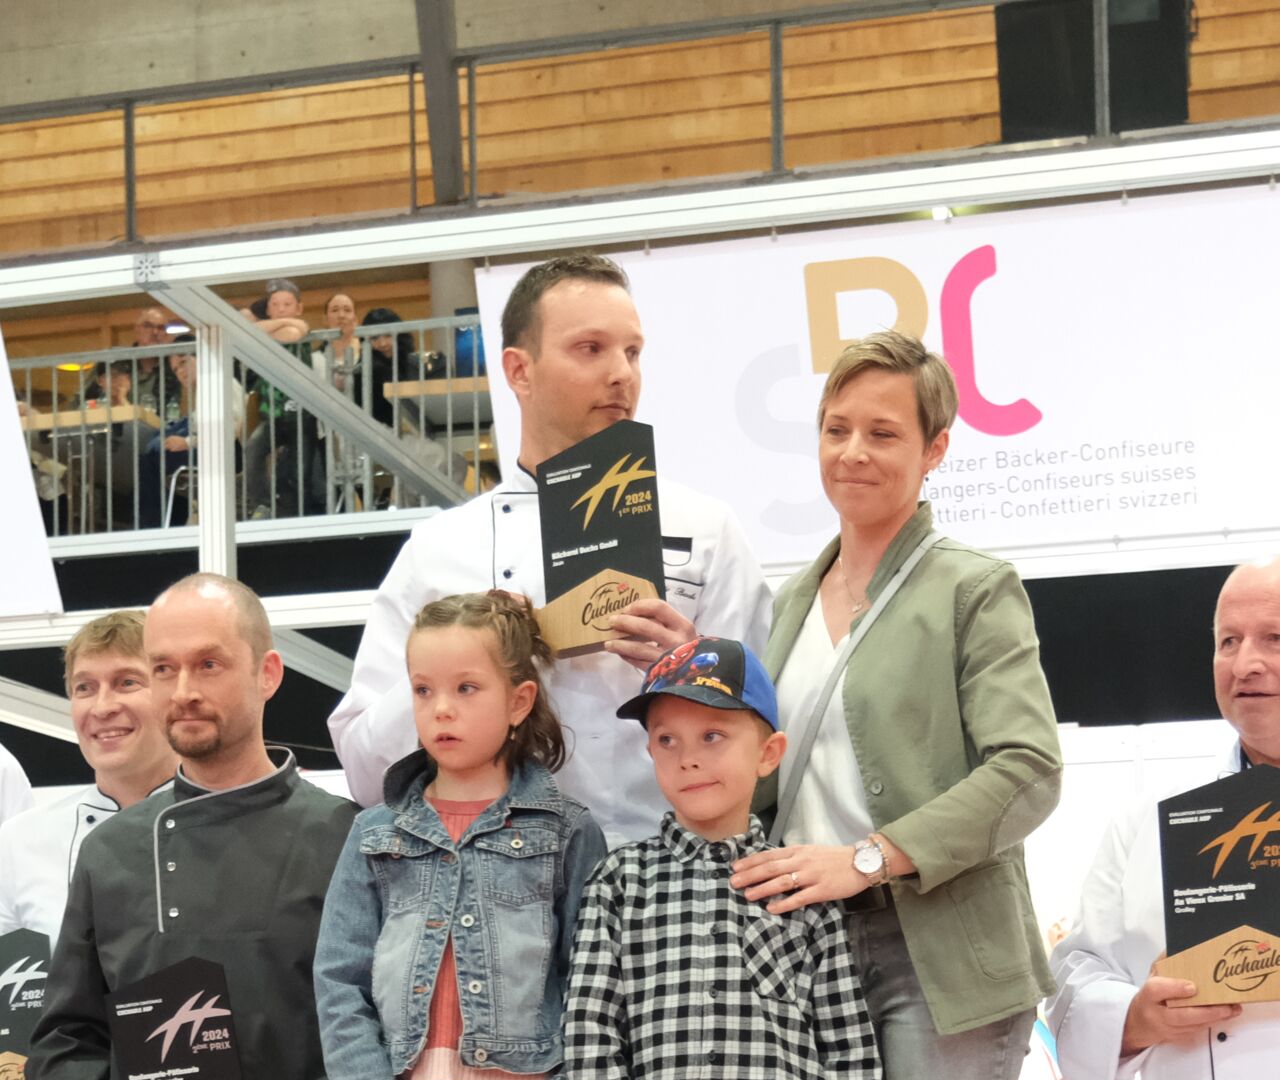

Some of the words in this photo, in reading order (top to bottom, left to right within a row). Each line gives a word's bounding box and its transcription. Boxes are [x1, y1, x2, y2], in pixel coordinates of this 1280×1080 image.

[938, 455, 987, 474] eizer
[995, 440, 1195, 469] Bäcker-Confiseure
[923, 471, 1115, 502] langers-Confiseurs
[1121, 465, 1196, 482] suisses
[625, 491, 651, 505] 2024
[632, 503, 652, 515] PRIX
[937, 495, 1111, 524] ttieri-Confettieri
[1119, 487, 1198, 510] svizzeri
[582, 587, 640, 626] Cuchaule
[28, 1001, 44, 1009] PRI
[202, 1028, 229, 1042] 2024
[210, 1040, 231, 1051] PRIX
